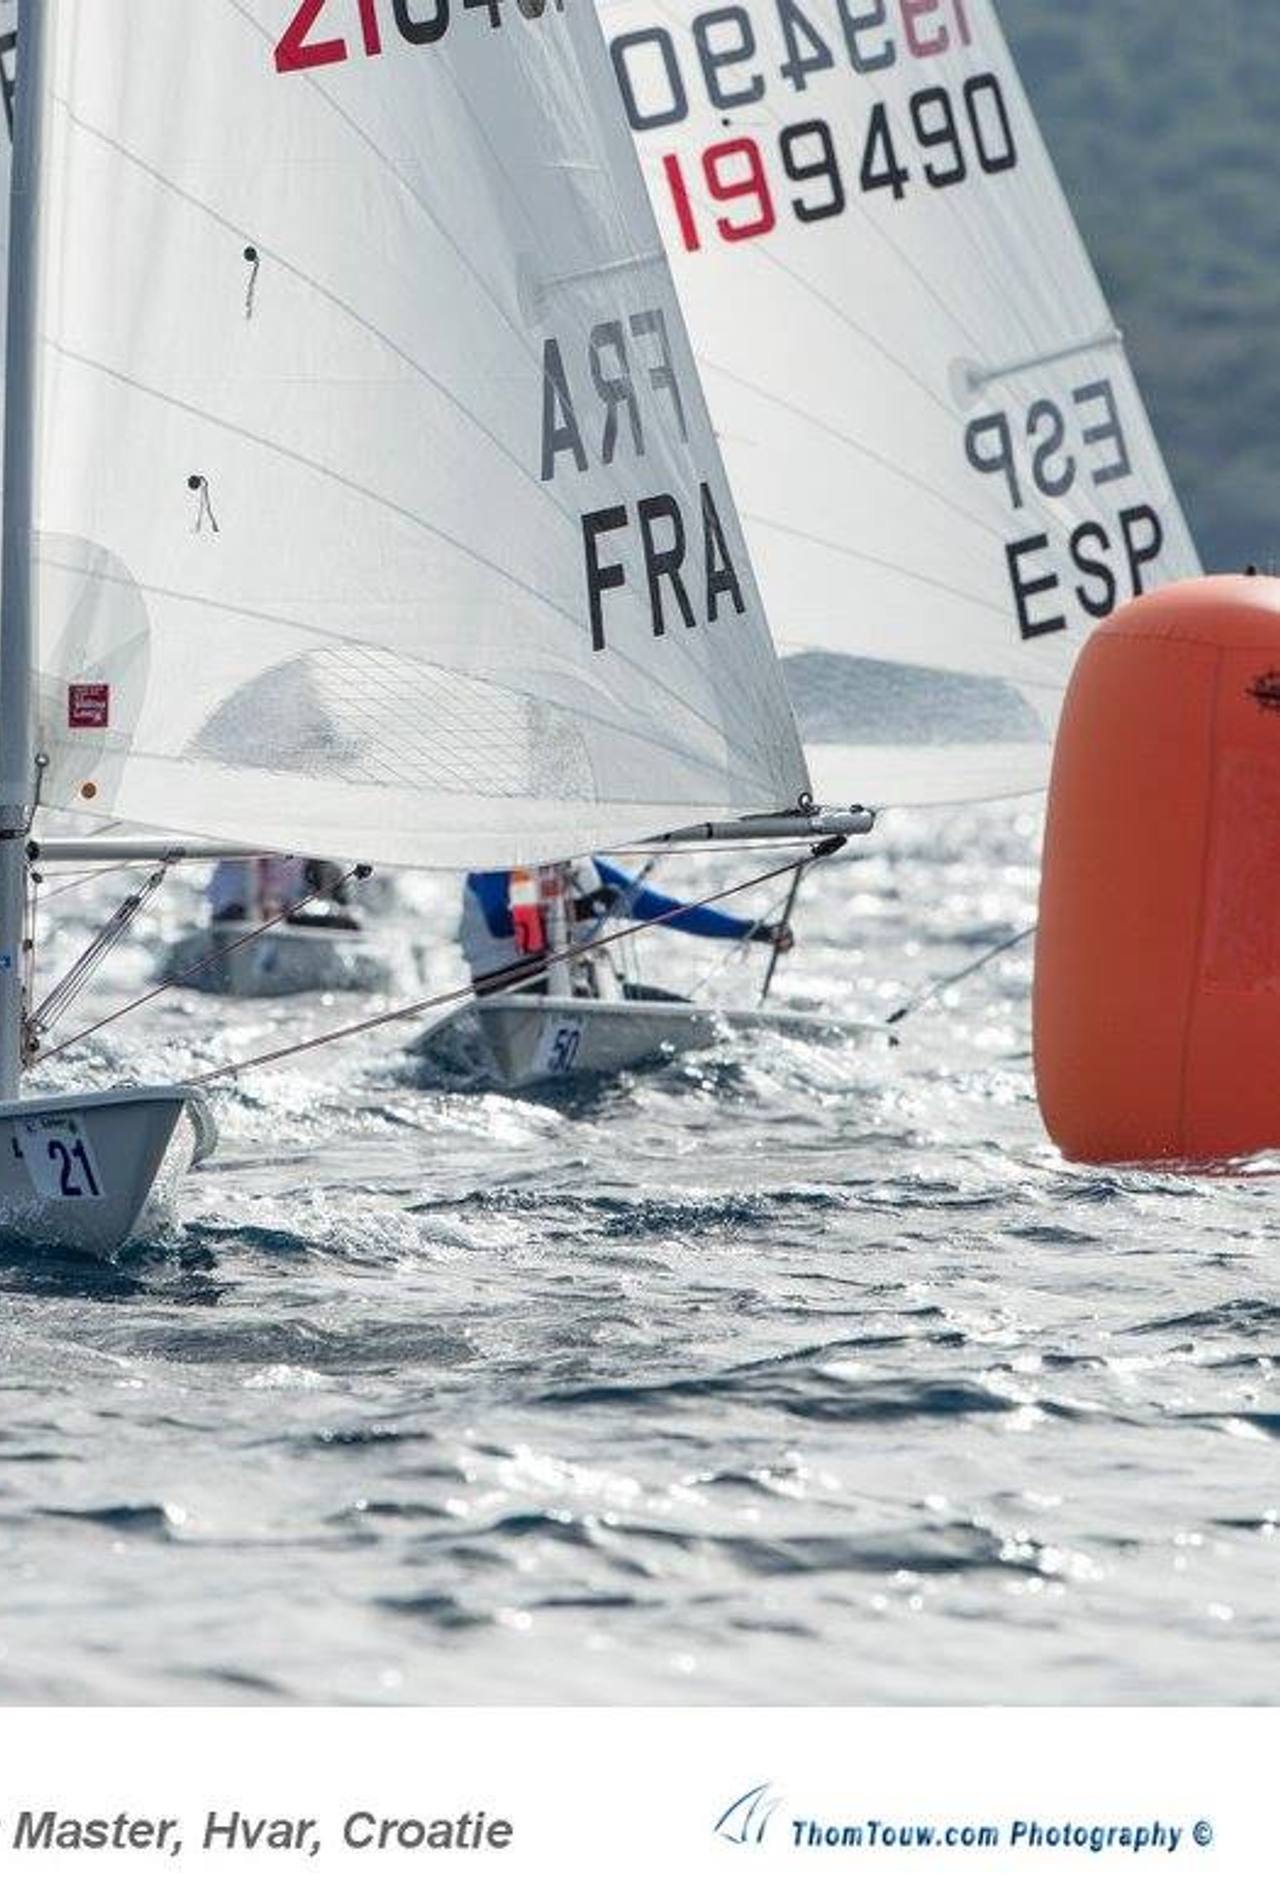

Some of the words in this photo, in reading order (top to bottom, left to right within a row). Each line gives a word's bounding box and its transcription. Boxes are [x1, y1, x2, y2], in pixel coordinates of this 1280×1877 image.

[662, 72, 1017, 252] 199490
[580, 481, 746, 653] FRA
[1005, 504, 1164, 640] ESP
[47, 1138, 99, 1196] 21
